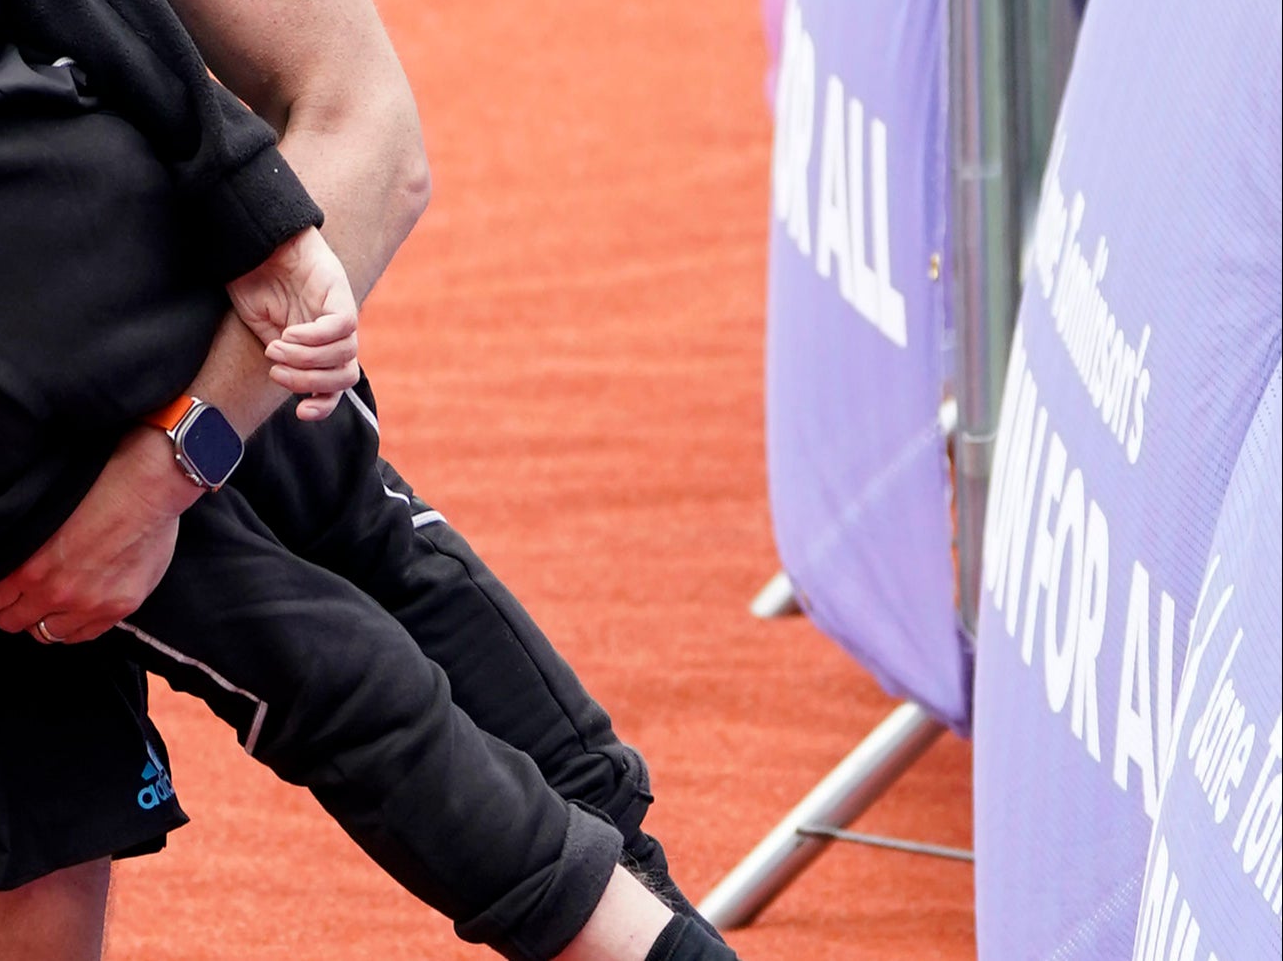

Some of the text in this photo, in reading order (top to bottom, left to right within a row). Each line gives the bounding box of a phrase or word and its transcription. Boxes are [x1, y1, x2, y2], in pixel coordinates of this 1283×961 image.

[816, 74, 908, 348] ALL
[1020, 431, 1110, 763] FOR
[1112, 559, 1175, 823] AL
